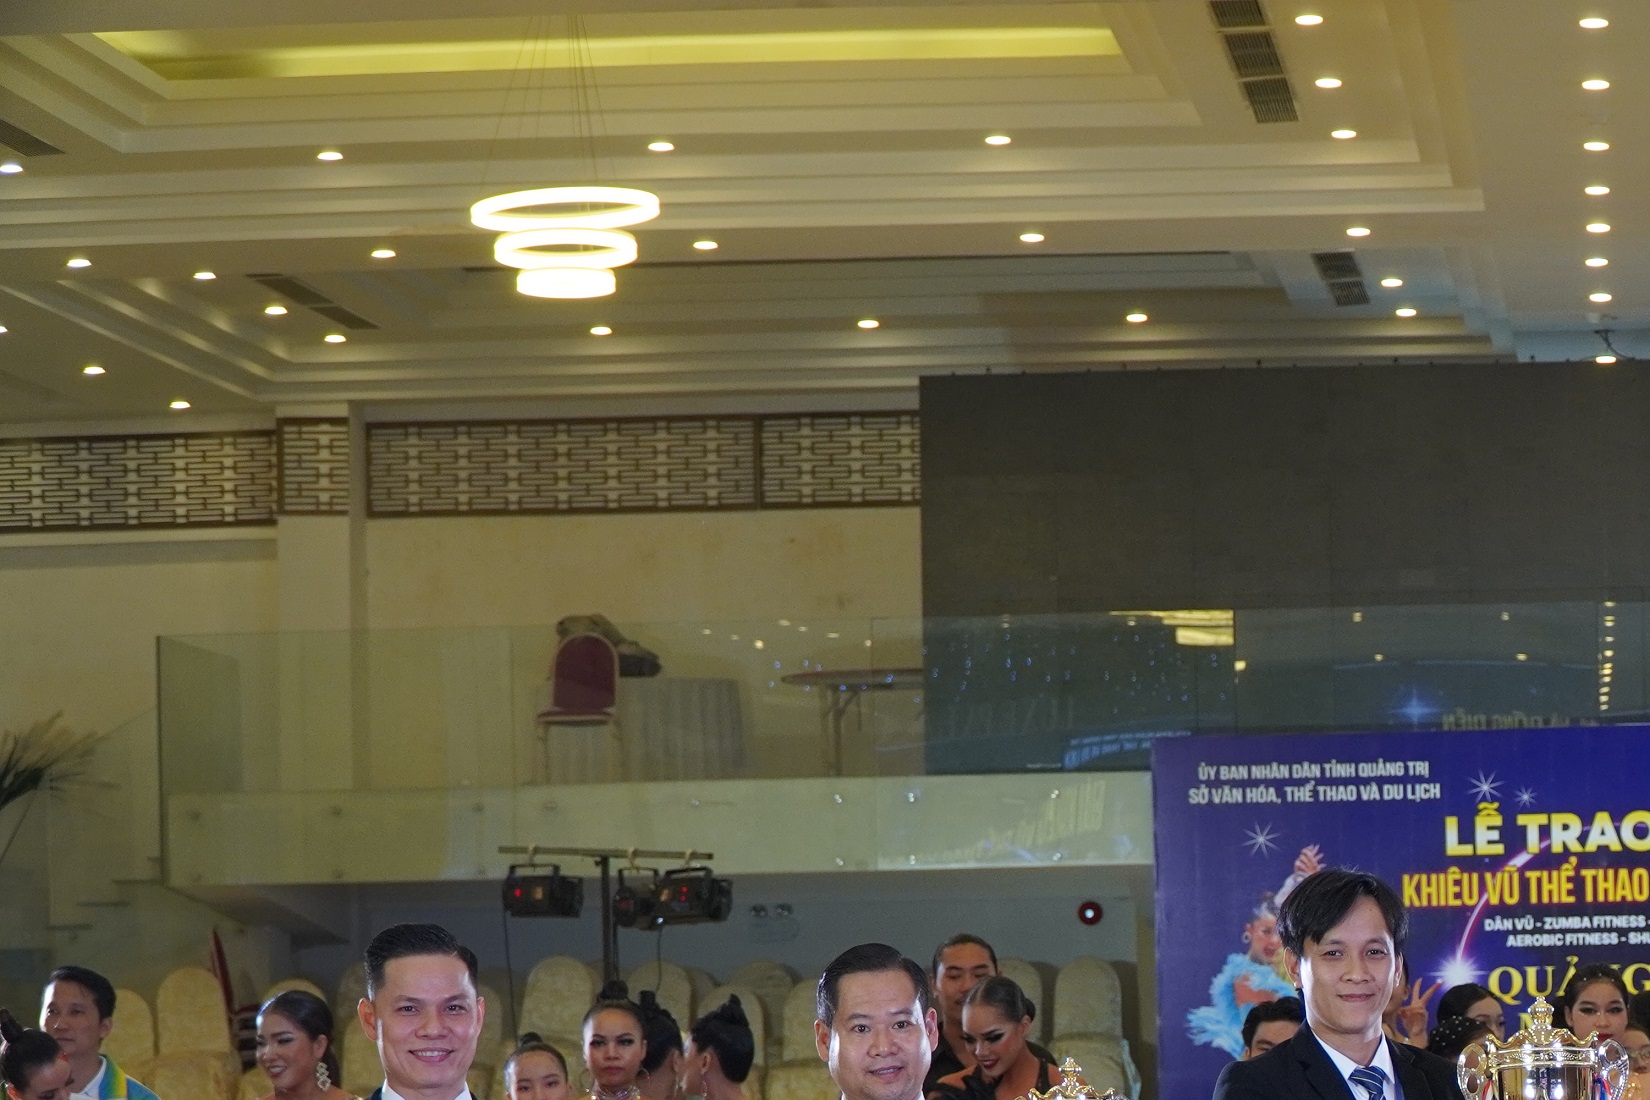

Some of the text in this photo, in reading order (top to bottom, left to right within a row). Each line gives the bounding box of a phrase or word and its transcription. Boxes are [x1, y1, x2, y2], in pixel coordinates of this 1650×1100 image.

[1198, 758, 1429, 780] ỦY BAN NHÂN DÂN TỈNH QUẢNG TRỊ
[1188, 788, 1211, 804] SỞ
[1212, 785, 1242, 803] VĂN
[1284, 781, 1316, 802] THỂ
[1317, 786, 1356, 801] THAO
[1360, 782, 1380, 800] VÀ
[1383, 785, 1404, 800] DU
[1407, 783, 1440, 802] LỊCH
[1444, 802, 1505, 856] LỄ
[1403, 866, 1479, 908] KHIÊU
[1486, 859, 1519, 906] VŨ
[1526, 855, 1578, 904] THỂ
[1581, 867, 1649, 903] THAO
[1484, 917, 1514, 931] DÂN
[1515, 914, 1534, 930] VŨ
[1543, 917, 1591, 929] ZUMBA
[1592, 915, 1646, 928] FITNESS
[1506, 933, 1562, 947] AEROBIC
[1566, 932, 1618, 946] FITNESS
